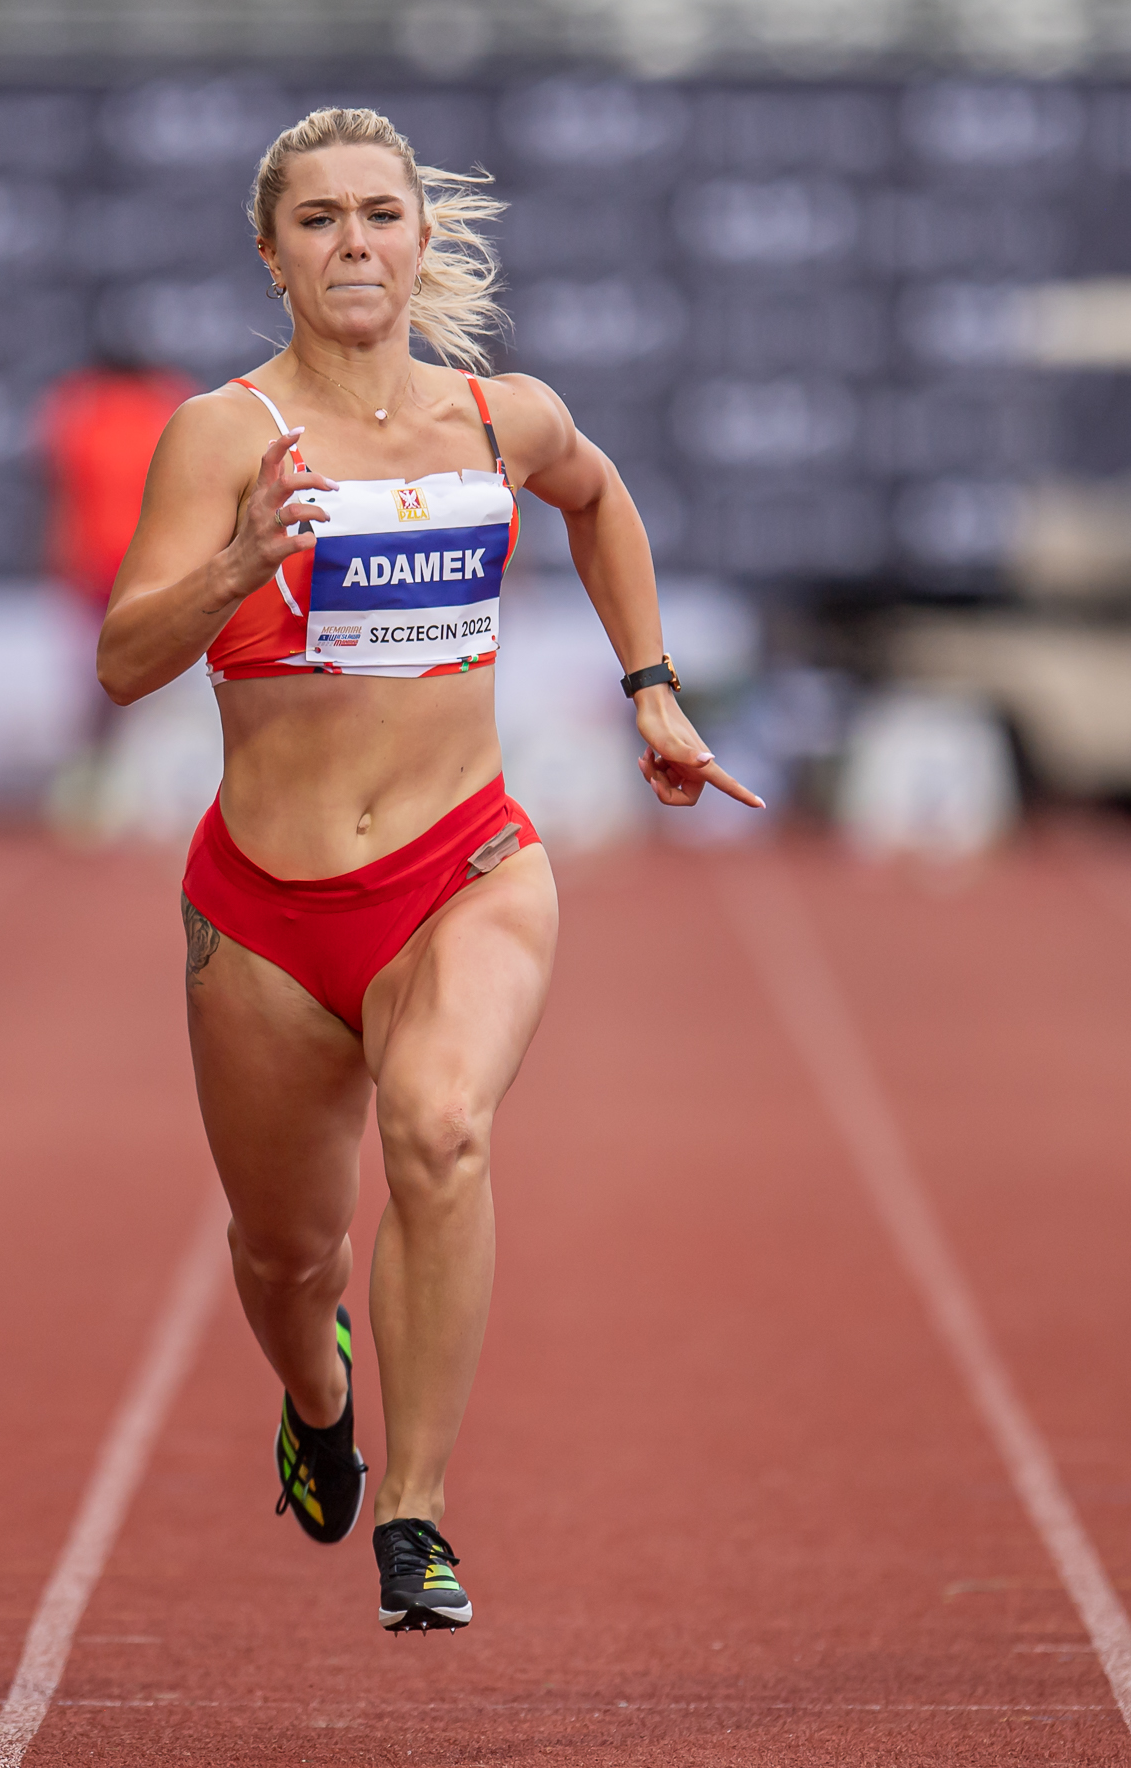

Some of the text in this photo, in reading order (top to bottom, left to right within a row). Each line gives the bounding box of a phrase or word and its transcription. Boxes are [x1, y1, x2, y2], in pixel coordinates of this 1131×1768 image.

[400, 509, 428, 520] PZLA
[342, 548, 486, 587] ADAMEK
[369, 616, 492, 644] SZCZECIN 2022
